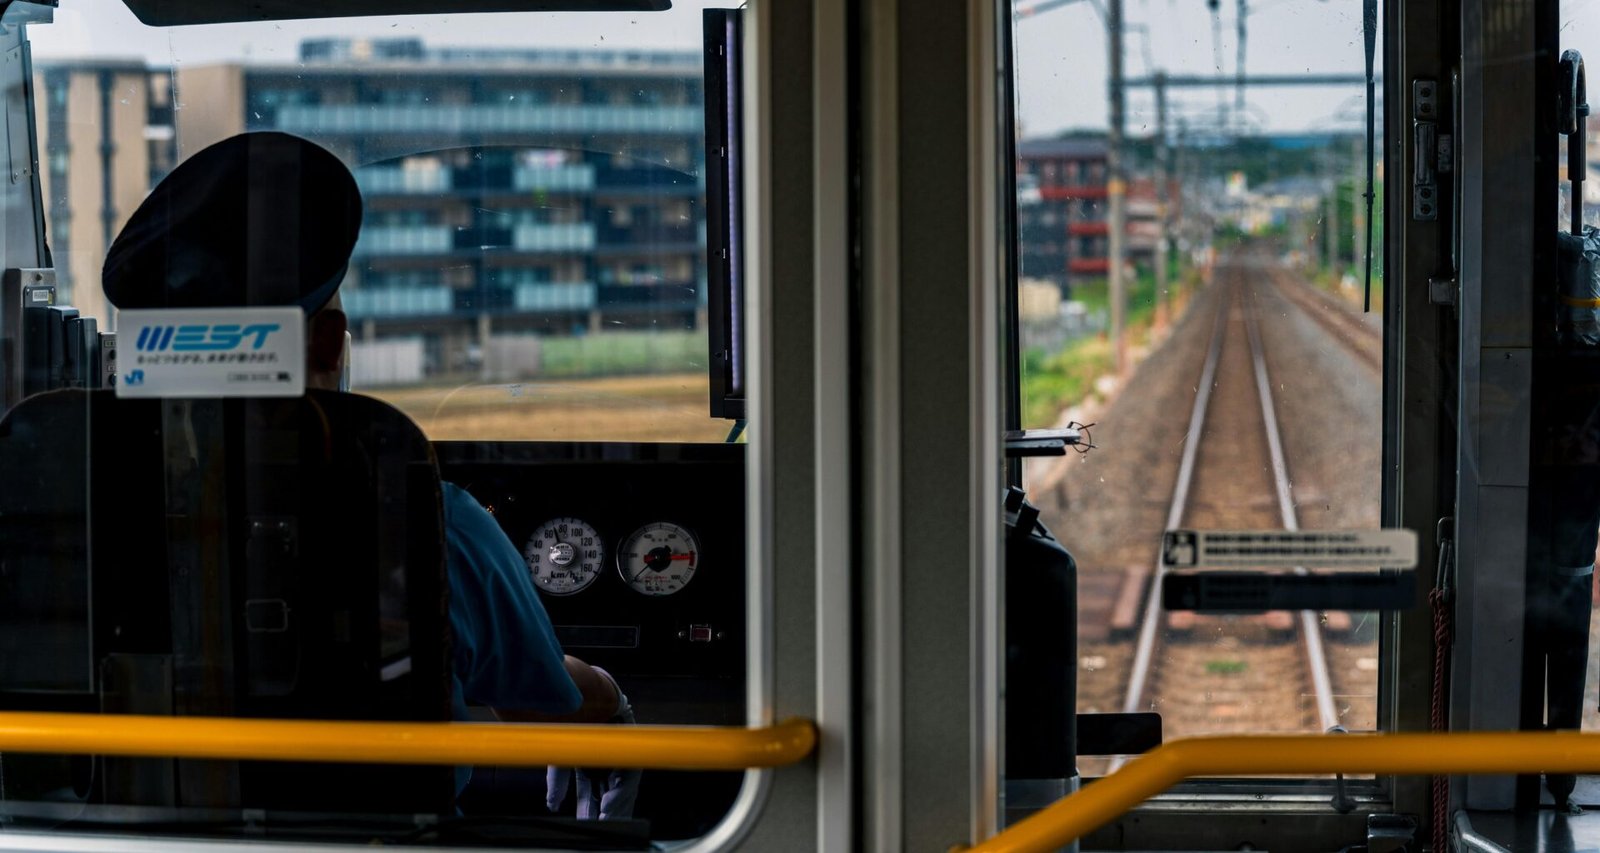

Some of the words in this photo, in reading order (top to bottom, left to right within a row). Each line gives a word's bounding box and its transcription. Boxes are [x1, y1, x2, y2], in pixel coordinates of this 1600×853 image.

[124, 369, 145, 386] JR
[559, 524, 568, 533] 80
[571, 528, 583, 537] 100
[544, 529, 553, 539] 60
[534, 540, 543, 549] 40
[581, 537, 593, 546] 120
[531, 554, 540, 563] 20
[585, 550, 597, 559] 140
[534, 566, 539, 575] 0
[581, 563, 593, 572] 160
[550, 570, 576, 579] km/h
